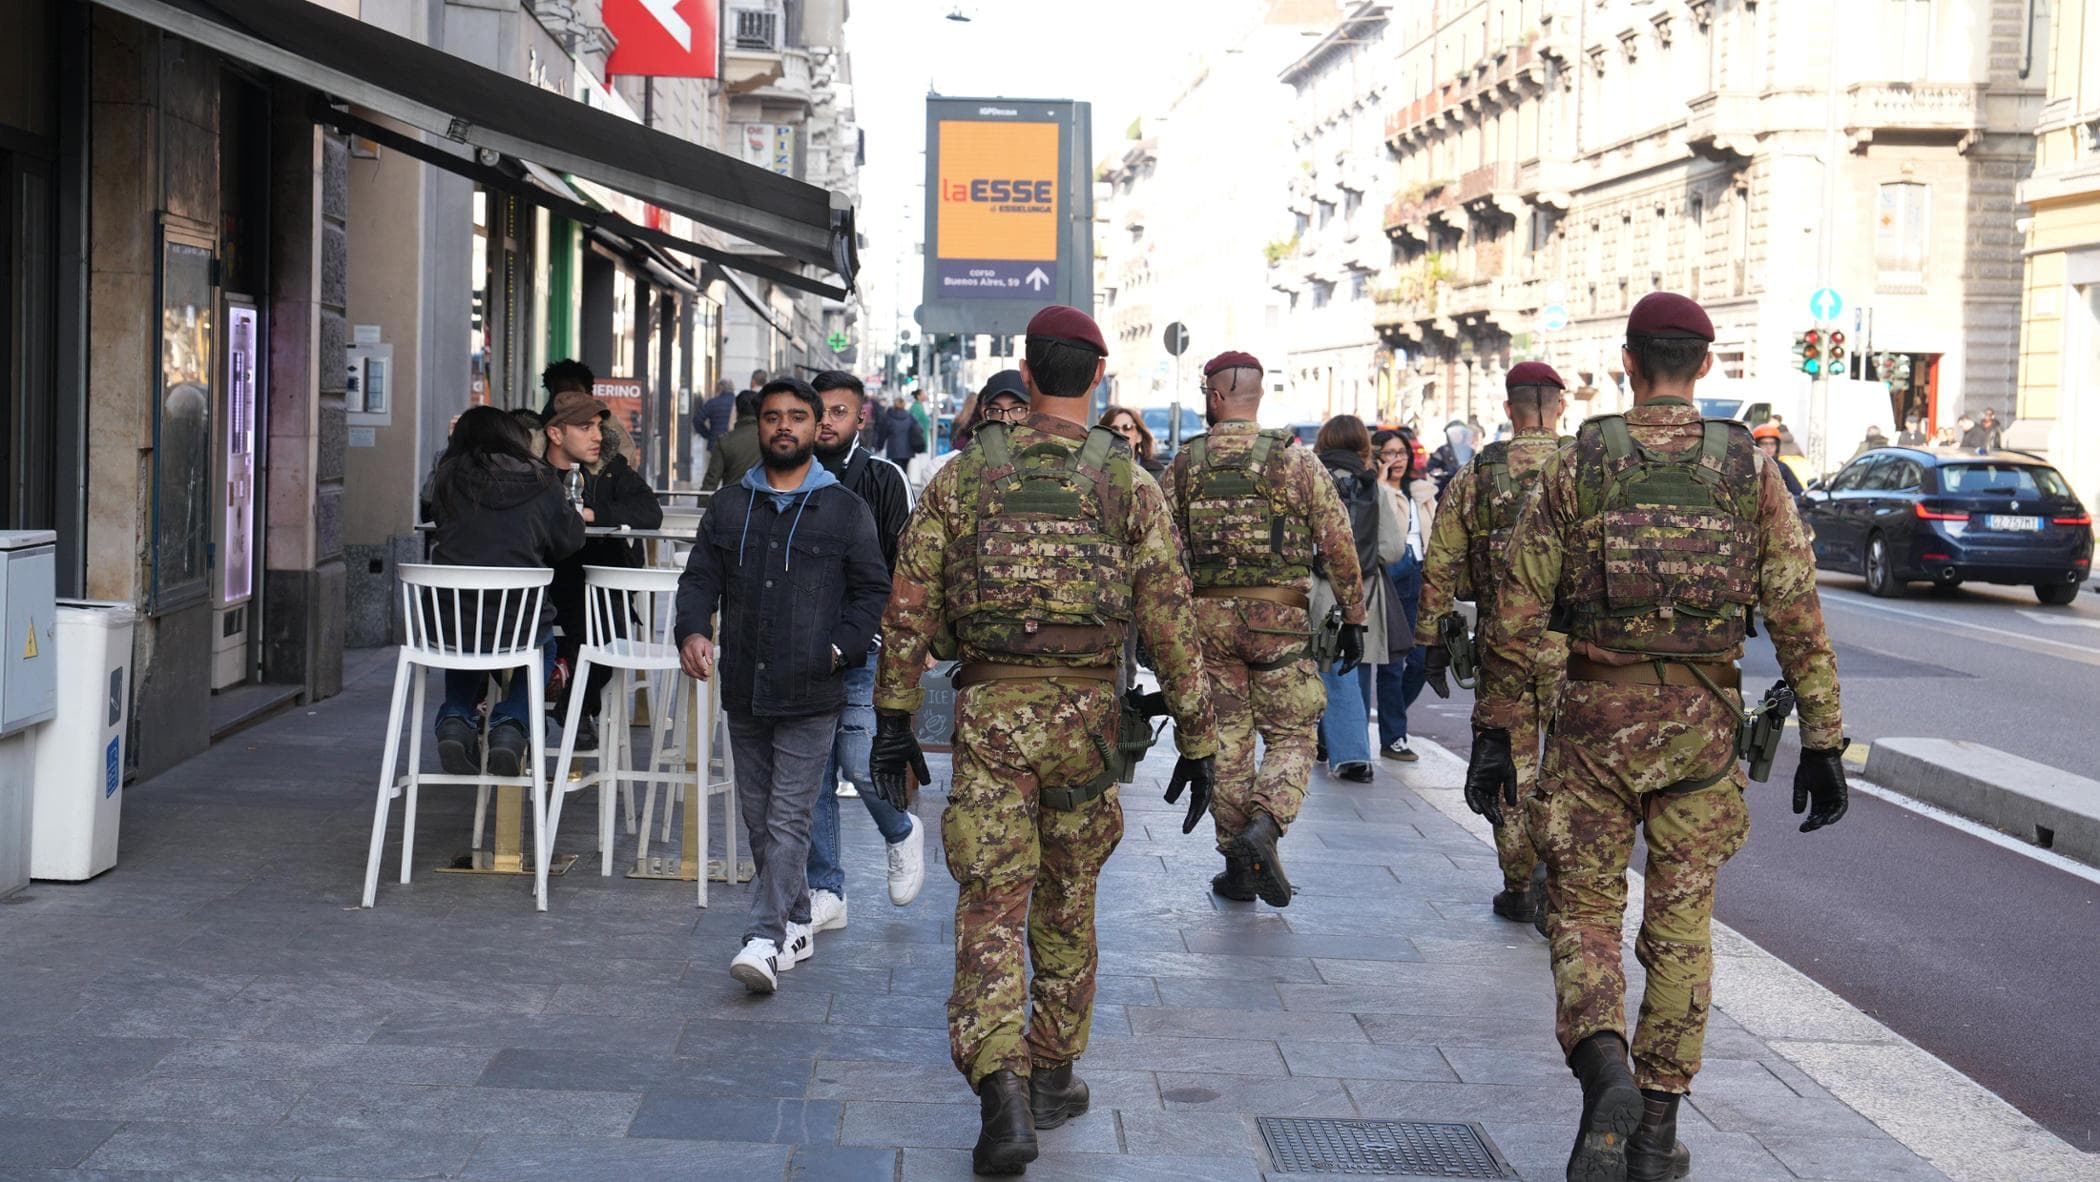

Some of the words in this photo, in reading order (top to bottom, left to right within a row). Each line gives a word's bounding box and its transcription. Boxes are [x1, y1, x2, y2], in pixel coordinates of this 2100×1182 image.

[969, 268, 996, 278] corso
[944, 276, 978, 286] Buenos
[980, 278, 1006, 288] Aires,
